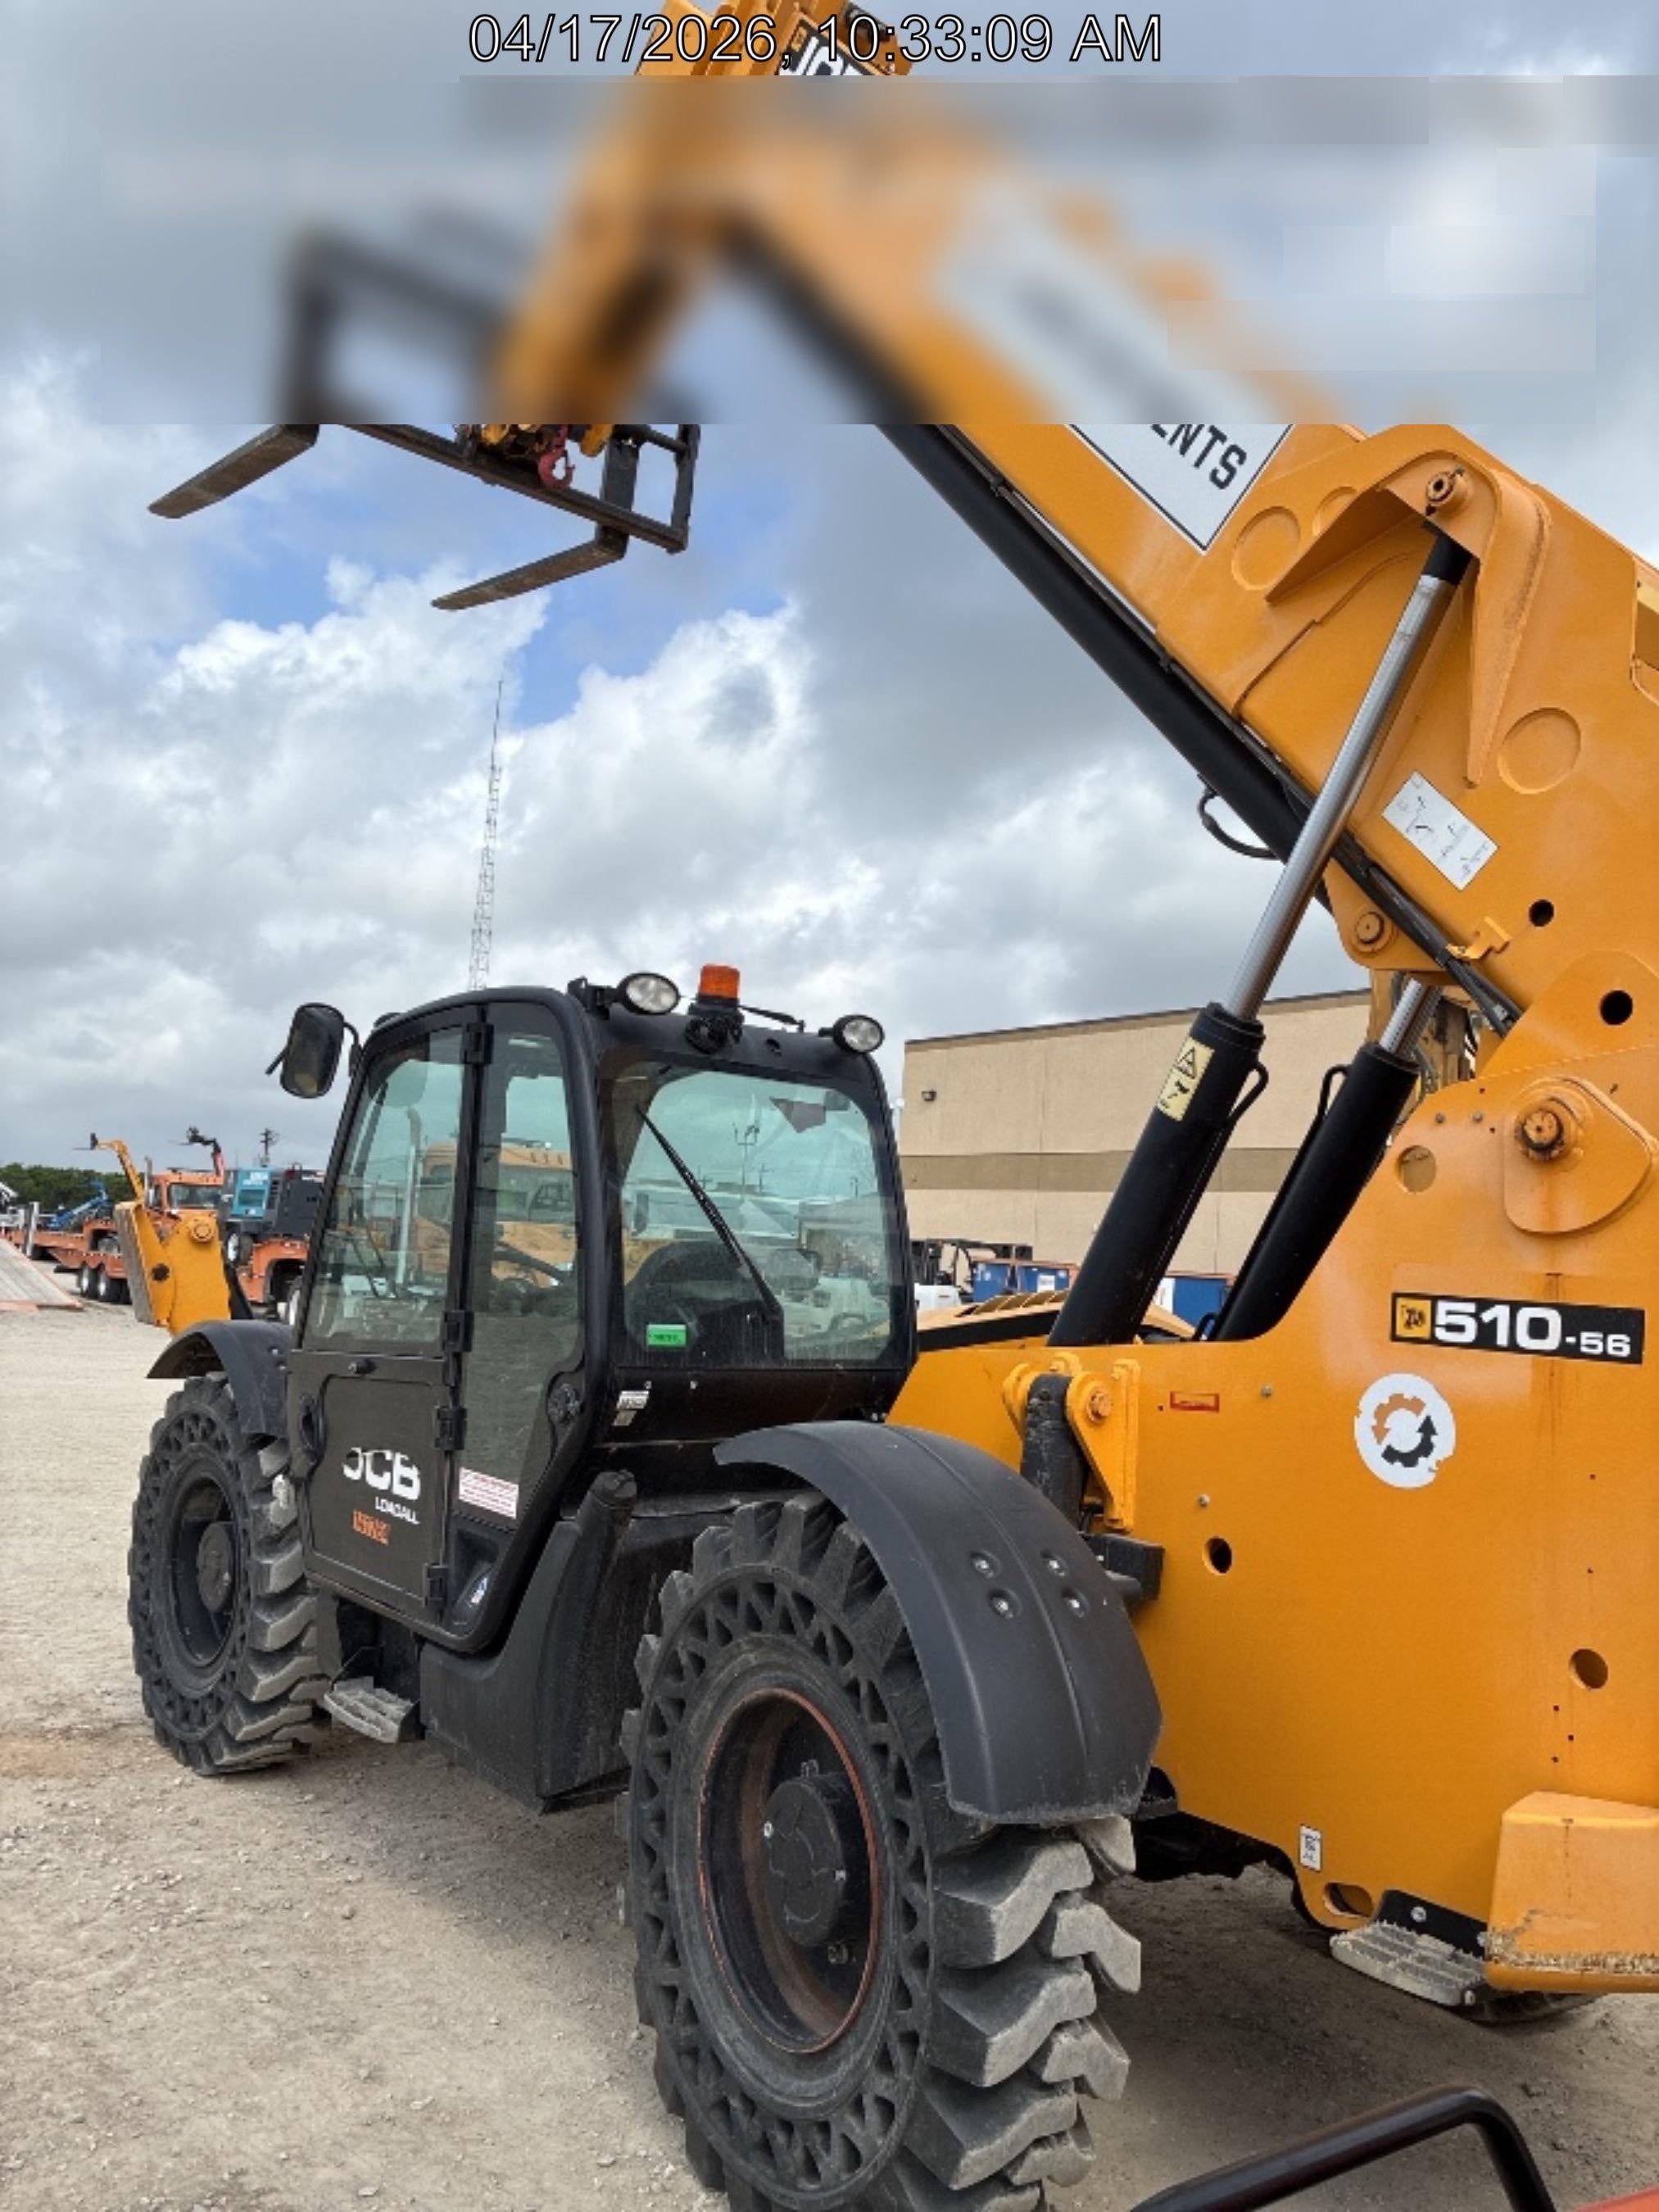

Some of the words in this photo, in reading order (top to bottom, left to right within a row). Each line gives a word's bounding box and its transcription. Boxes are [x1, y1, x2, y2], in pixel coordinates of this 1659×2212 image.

[1150, 424, 1247, 490] NTS
[1435, 1300, 1631, 1358] 510-56
[341, 1447, 421, 1500] JCB
